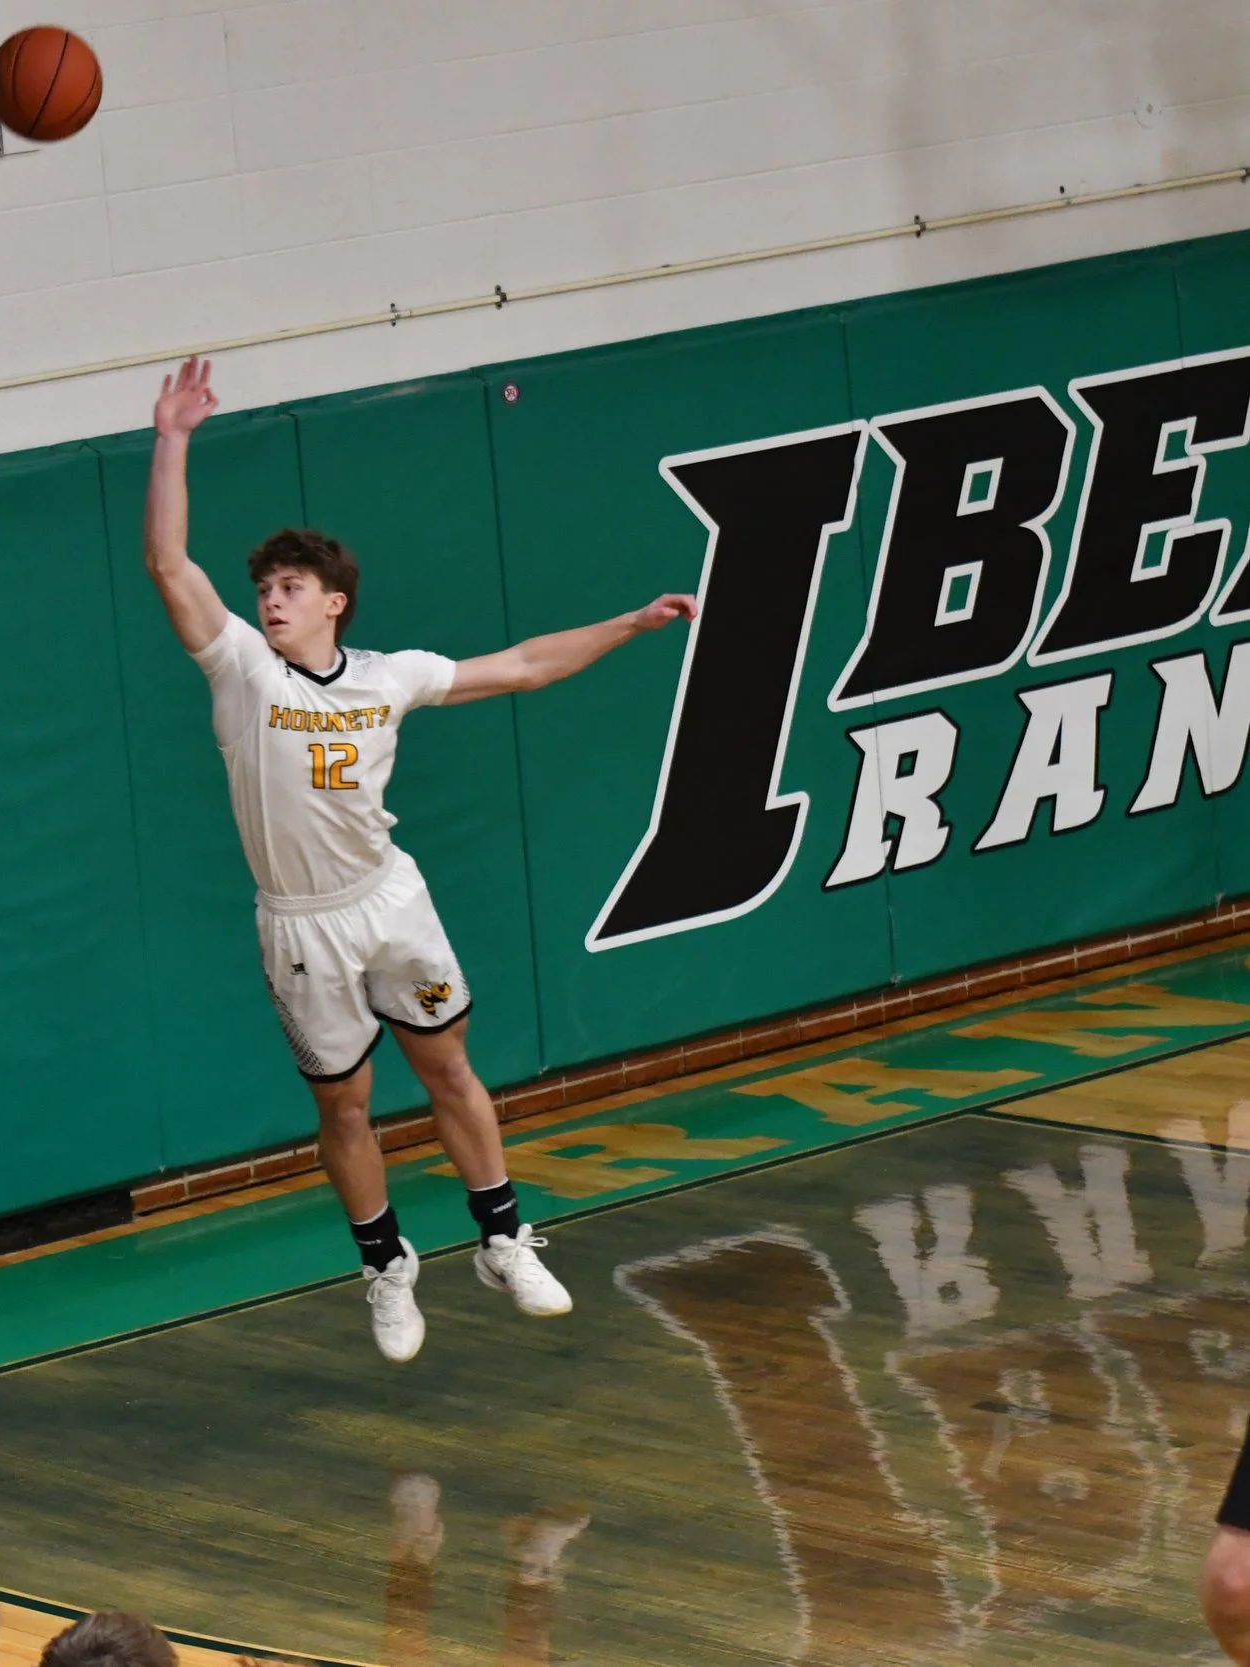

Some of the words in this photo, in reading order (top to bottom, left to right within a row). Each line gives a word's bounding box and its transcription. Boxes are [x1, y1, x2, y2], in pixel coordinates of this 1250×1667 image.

[584, 345, 1250, 953] IBE
[269, 704, 391, 733] HORNETS
[307, 743, 360, 790] 12
